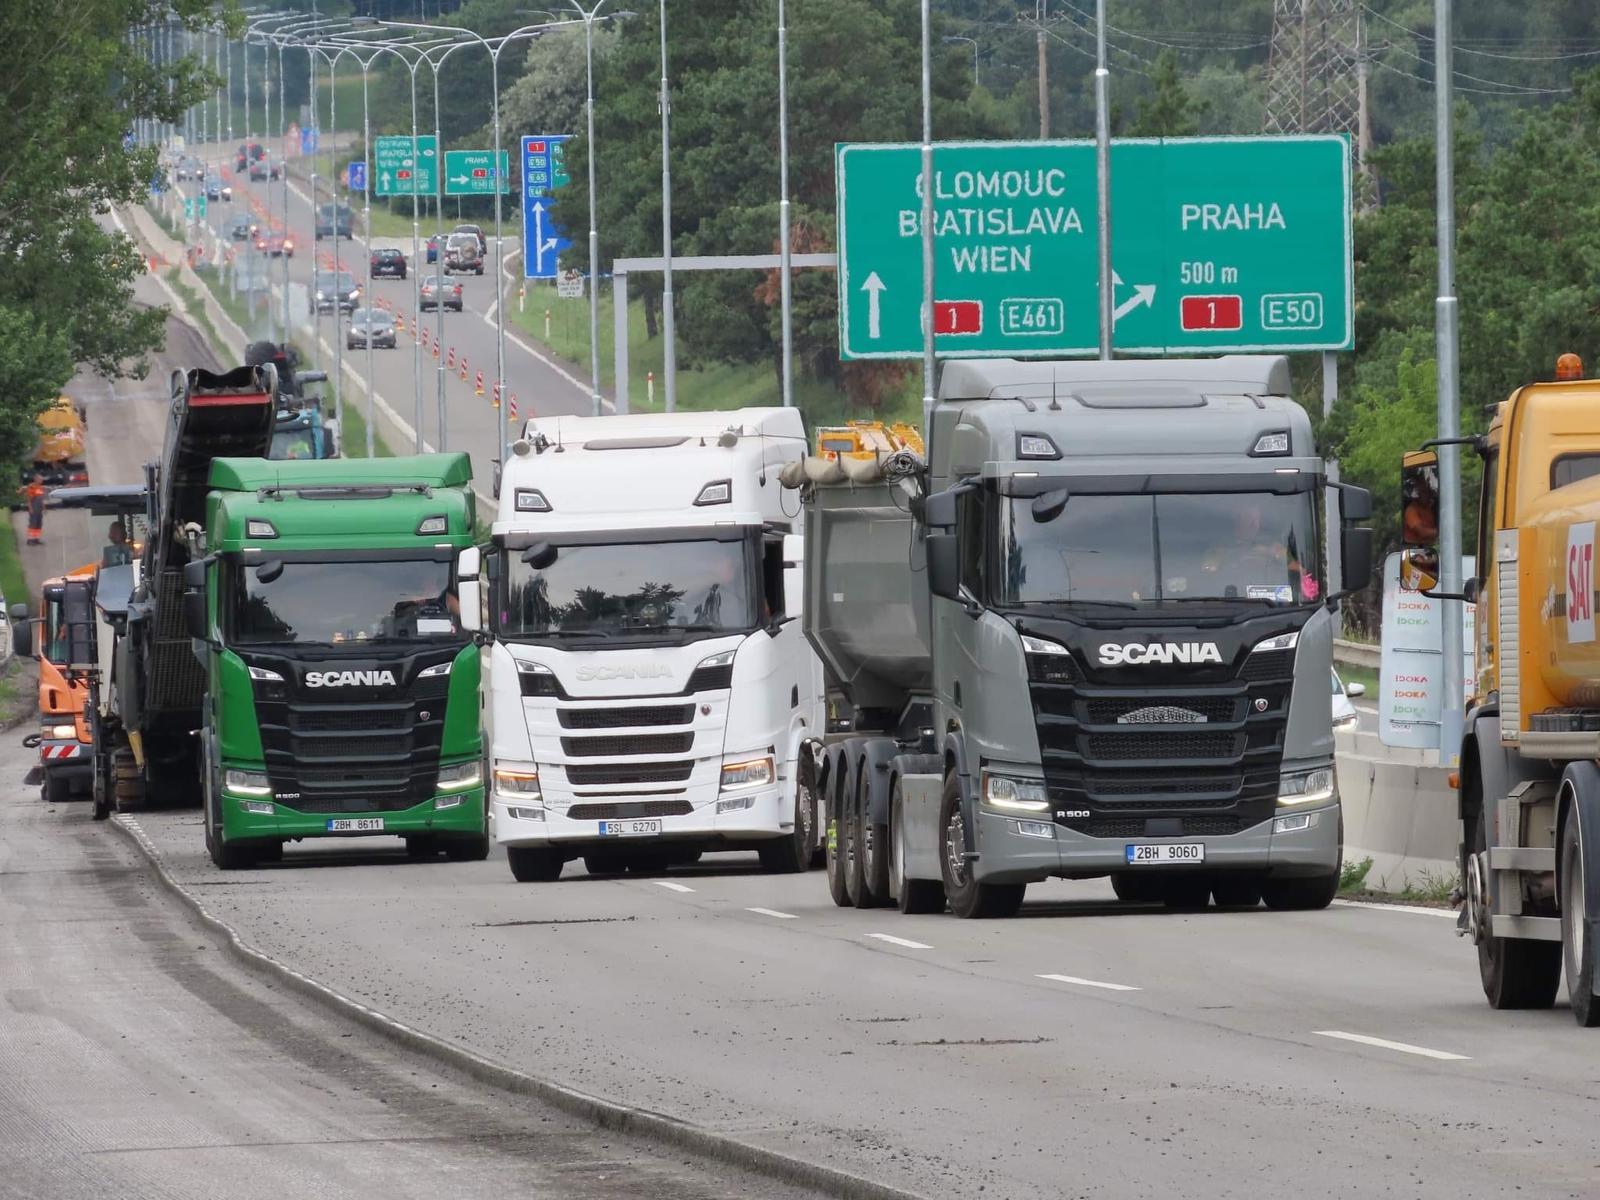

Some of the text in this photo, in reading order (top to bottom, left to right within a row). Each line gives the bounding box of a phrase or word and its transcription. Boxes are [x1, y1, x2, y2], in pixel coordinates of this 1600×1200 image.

[1181, 202, 1286, 231] PRAHA
[951, 245, 1032, 274] WIEN
[1180, 261, 1238, 284] 500 m
[948, 308, 1056, 330] 1 E461
[1208, 300, 1316, 324] 1 E50
[1568, 544, 1592, 623] SAT
[1098, 641, 1222, 665] SCANIA
[305, 670, 396, 688] SCANIA
[576, 664, 673, 682] SCANIA
[335, 820, 380, 830] 2BH 8611
[608, 822, 656, 833] 5SL 6270
[1137, 846, 1198, 859] 2BH 9060
